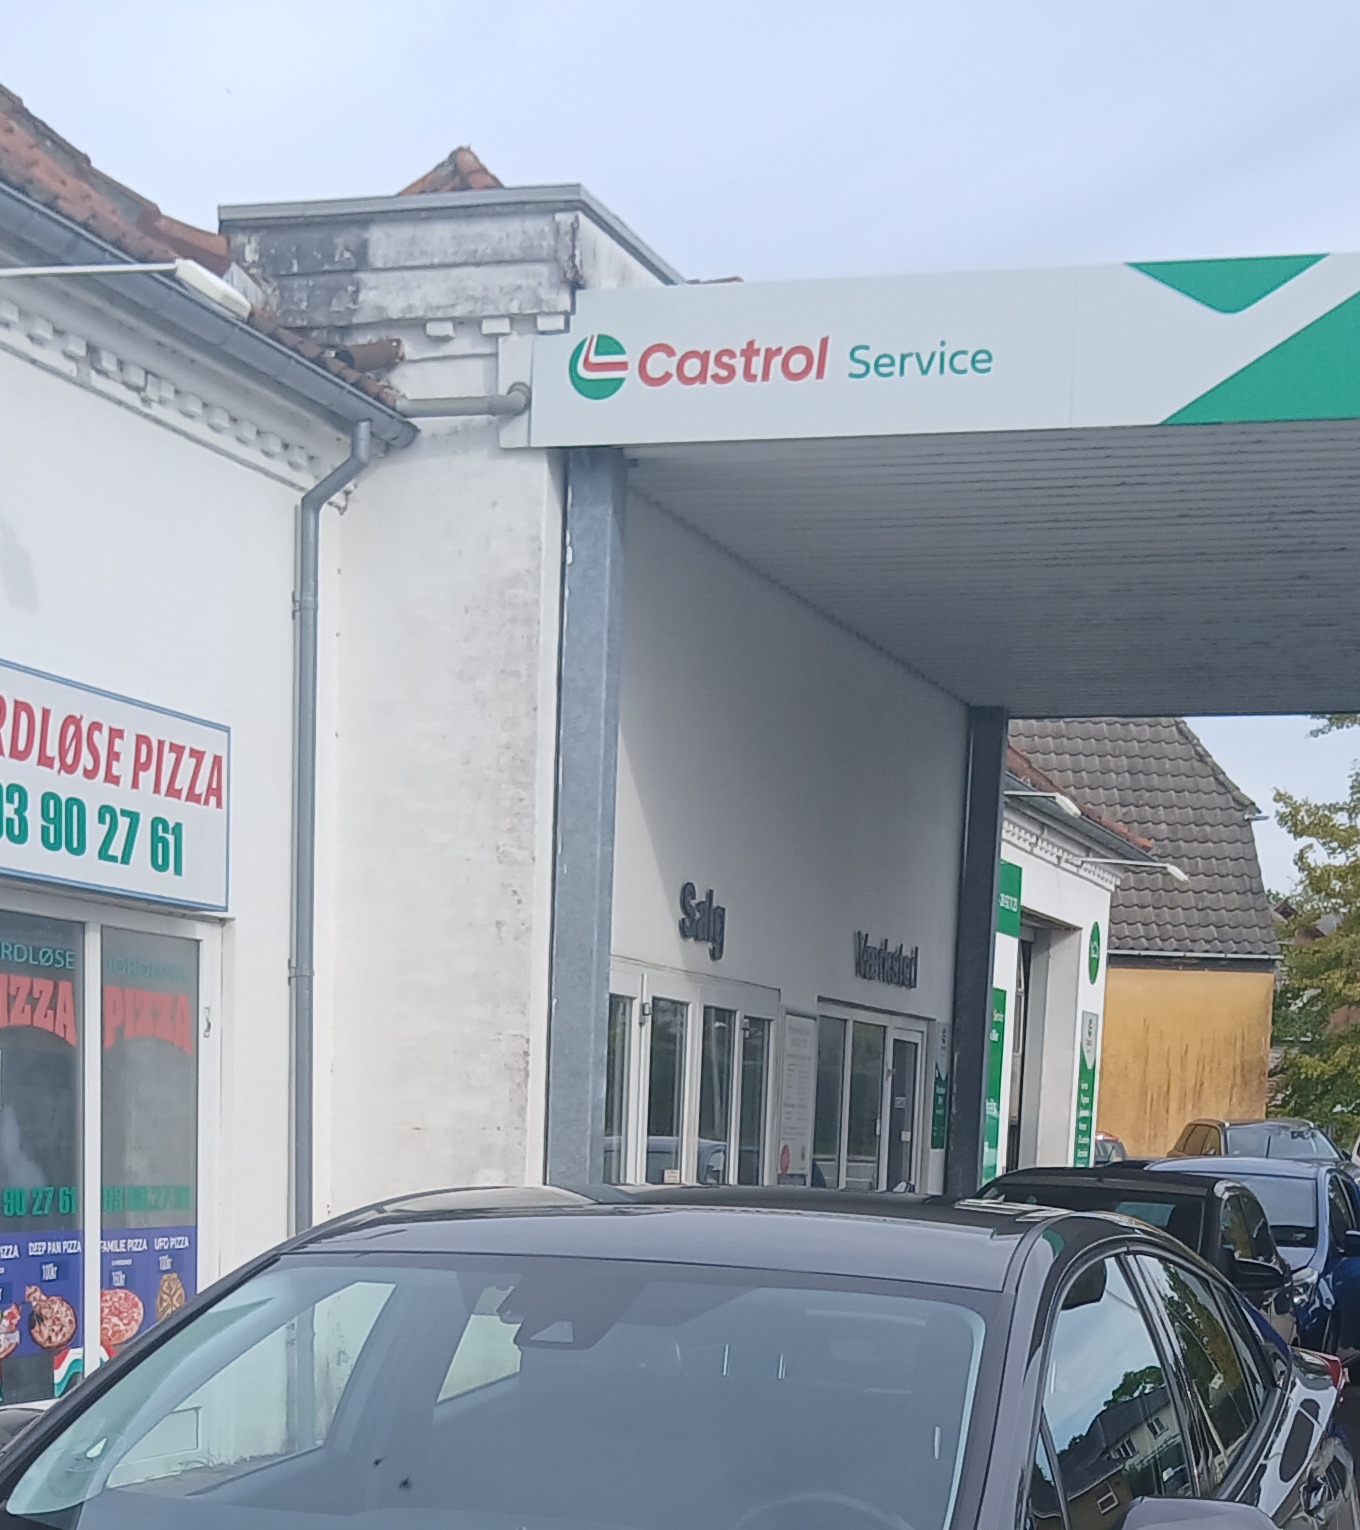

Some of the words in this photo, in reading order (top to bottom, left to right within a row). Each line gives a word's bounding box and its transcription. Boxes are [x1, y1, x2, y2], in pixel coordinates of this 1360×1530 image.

[638, 335, 830, 388] Castrol
[847, 340, 994, 379] Service
[131, 733, 223, 809] PIZZA
[40, 791, 87, 857] 90
[97, 804, 141, 866] 27
[150, 815, 184, 877] 61
[678, 881, 726, 961] Salg
[103, 985, 193, 1055] PIZZA
[31, 1186, 55, 1216] 27
[63, 1239, 82, 1254] PIZZA
[128, 1238, 148, 1252] PIZZA
[170, 1236, 189, 1249] PIZZA
